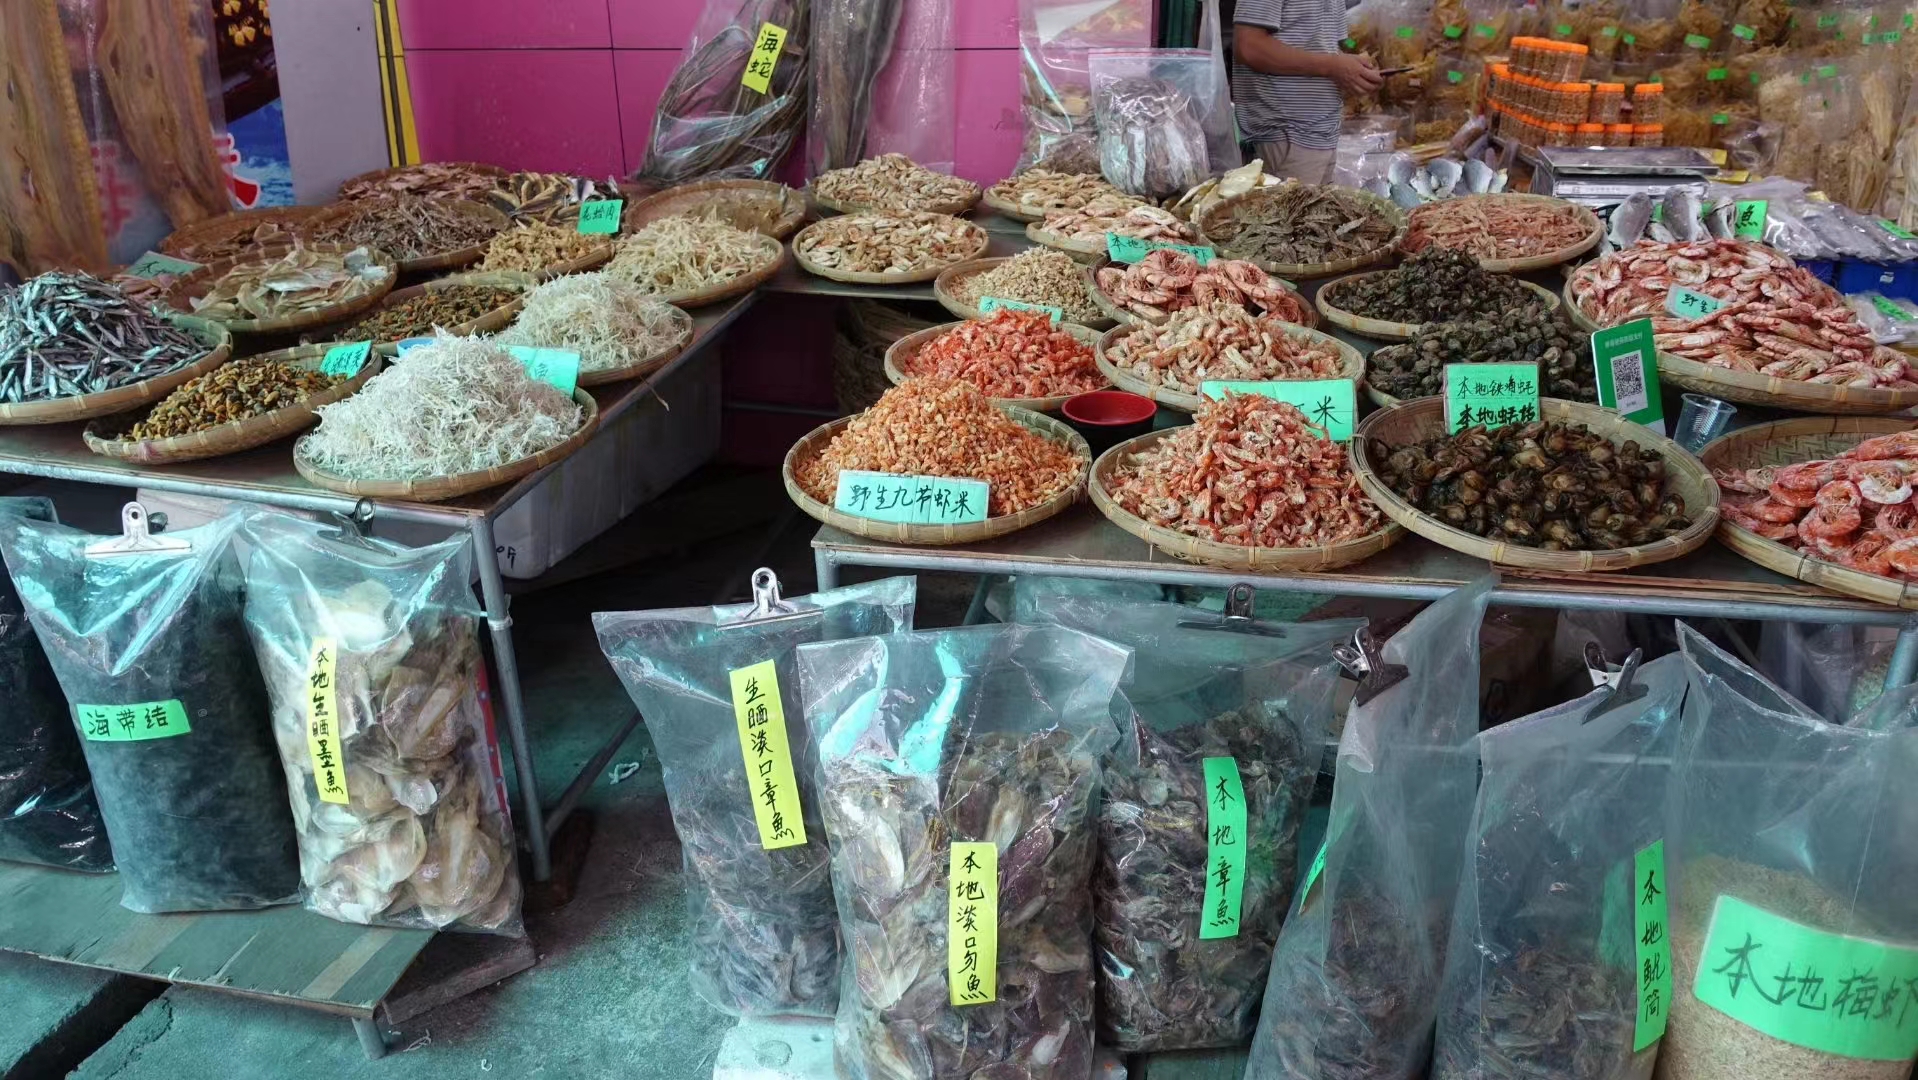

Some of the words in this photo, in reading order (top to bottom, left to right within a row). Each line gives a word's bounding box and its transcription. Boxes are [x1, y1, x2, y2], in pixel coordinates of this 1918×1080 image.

[747, 29, 779, 79] 海蛇
[847, 484, 976, 519] 野生九节虾米
[86, 704, 169, 740] 海带结
[744, 676, 795, 841] 生晒淡口章魚
[1209, 775, 1236, 928] 本地章魚
